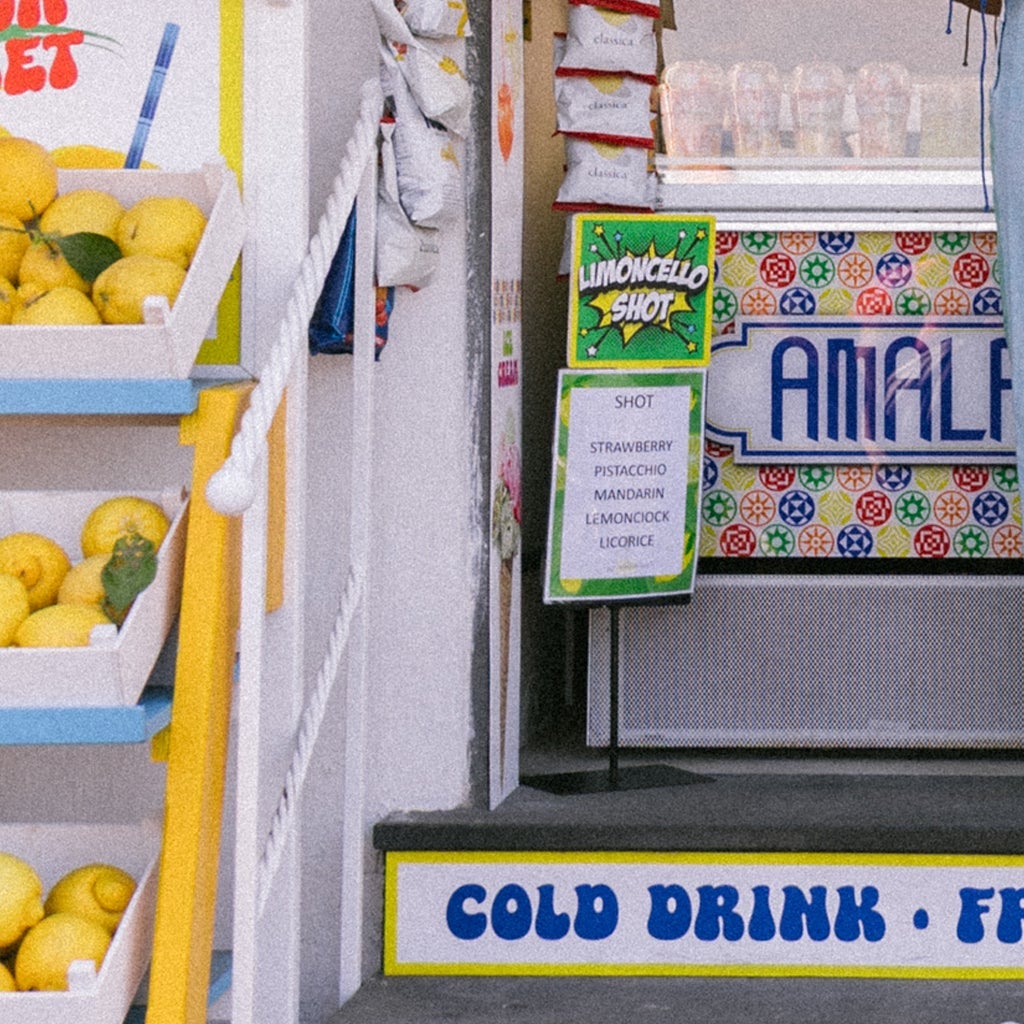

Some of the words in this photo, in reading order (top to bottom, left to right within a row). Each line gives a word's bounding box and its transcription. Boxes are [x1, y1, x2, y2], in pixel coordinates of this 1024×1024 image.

[593, 33, 634, 47] classica
[0, 30, 84, 96] ET
[588, 99, 628, 111] classica
[587, 167, 628, 180] classica
[577, 254, 710, 292] LIMONCELLO
[611, 290, 675, 324] SHOT
[771, 337, 1012, 443] AMALF
[615, 394, 655, 409] SHOT
[590, 440, 673, 454] STRAWBERRY
[594, 463, 667, 477] PISTACCHIO
[594, 487, 665, 501] MANDARIN
[585, 510, 670, 525] LEMONCIOCK
[599, 534, 655, 549] LICORICE
[446, 883, 619, 940] COLD
[646, 883, 886, 943] DRINK
